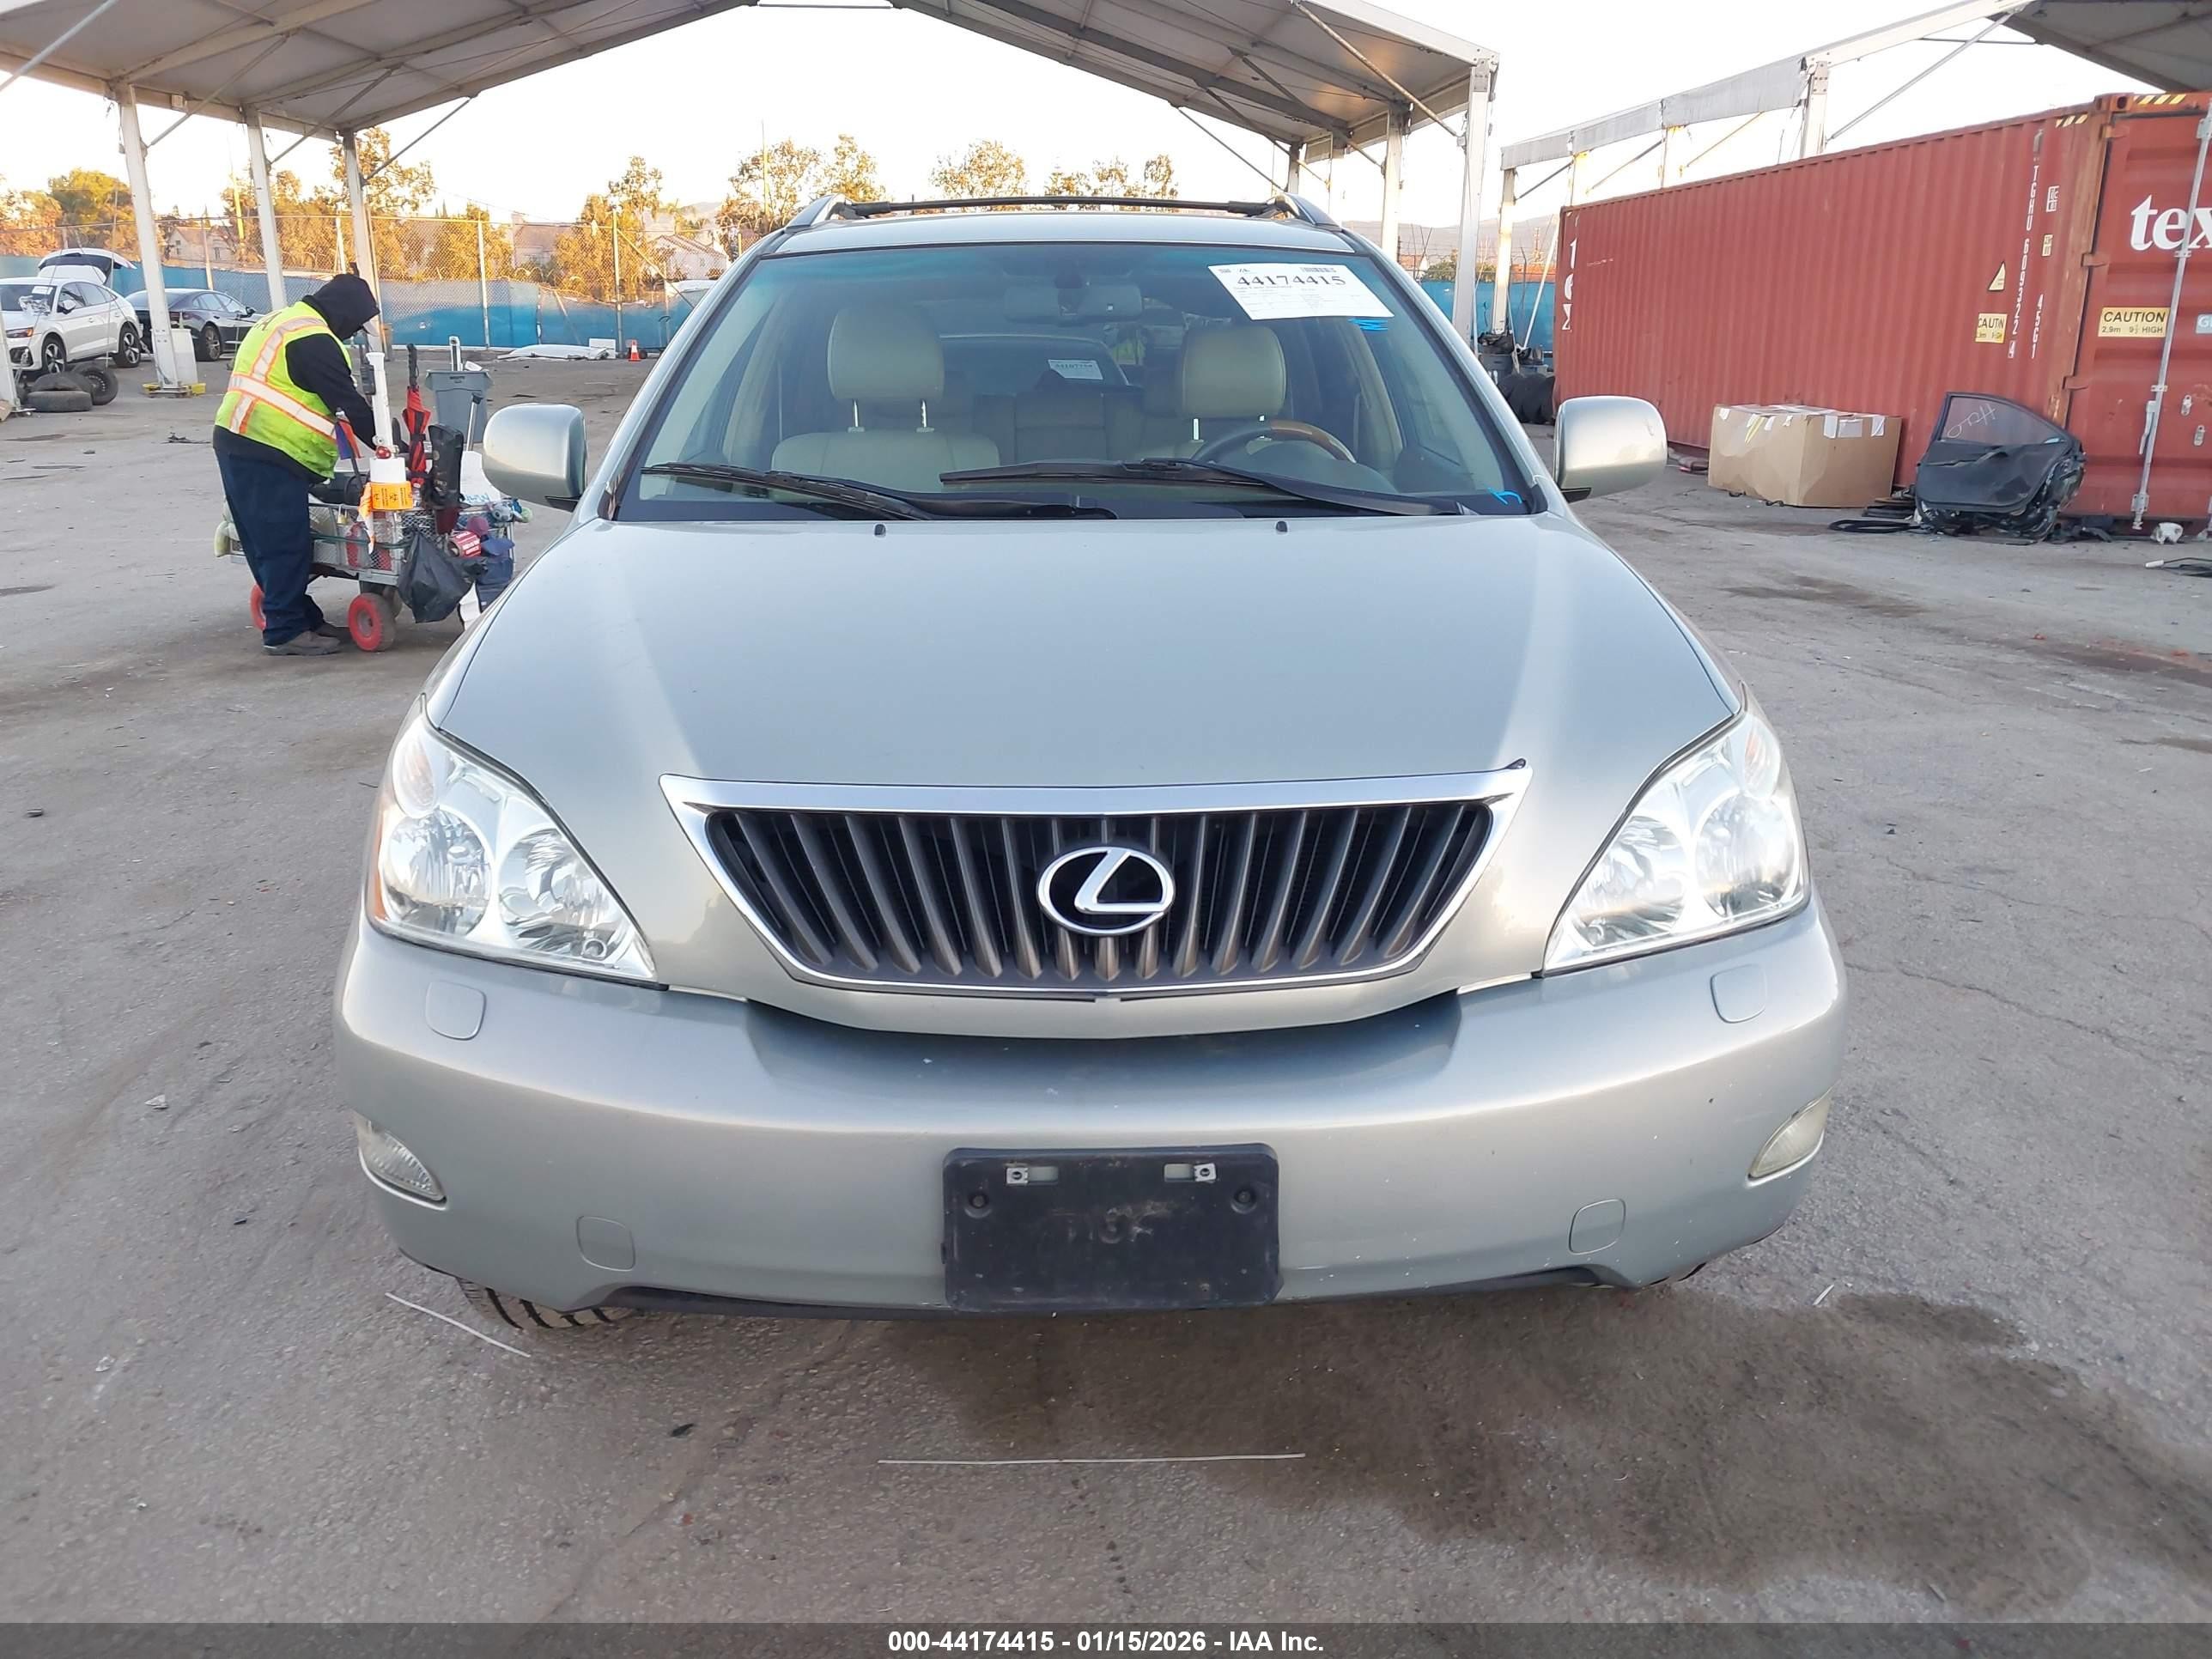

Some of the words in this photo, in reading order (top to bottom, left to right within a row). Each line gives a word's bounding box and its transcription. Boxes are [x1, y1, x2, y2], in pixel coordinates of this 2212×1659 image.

[2026, 165, 2039, 231] TGHU
[1237, 275, 1346, 286] 44174415
[2104, 311, 2166, 323] CAUTION
[2142, 325, 2163, 334] HIGH
